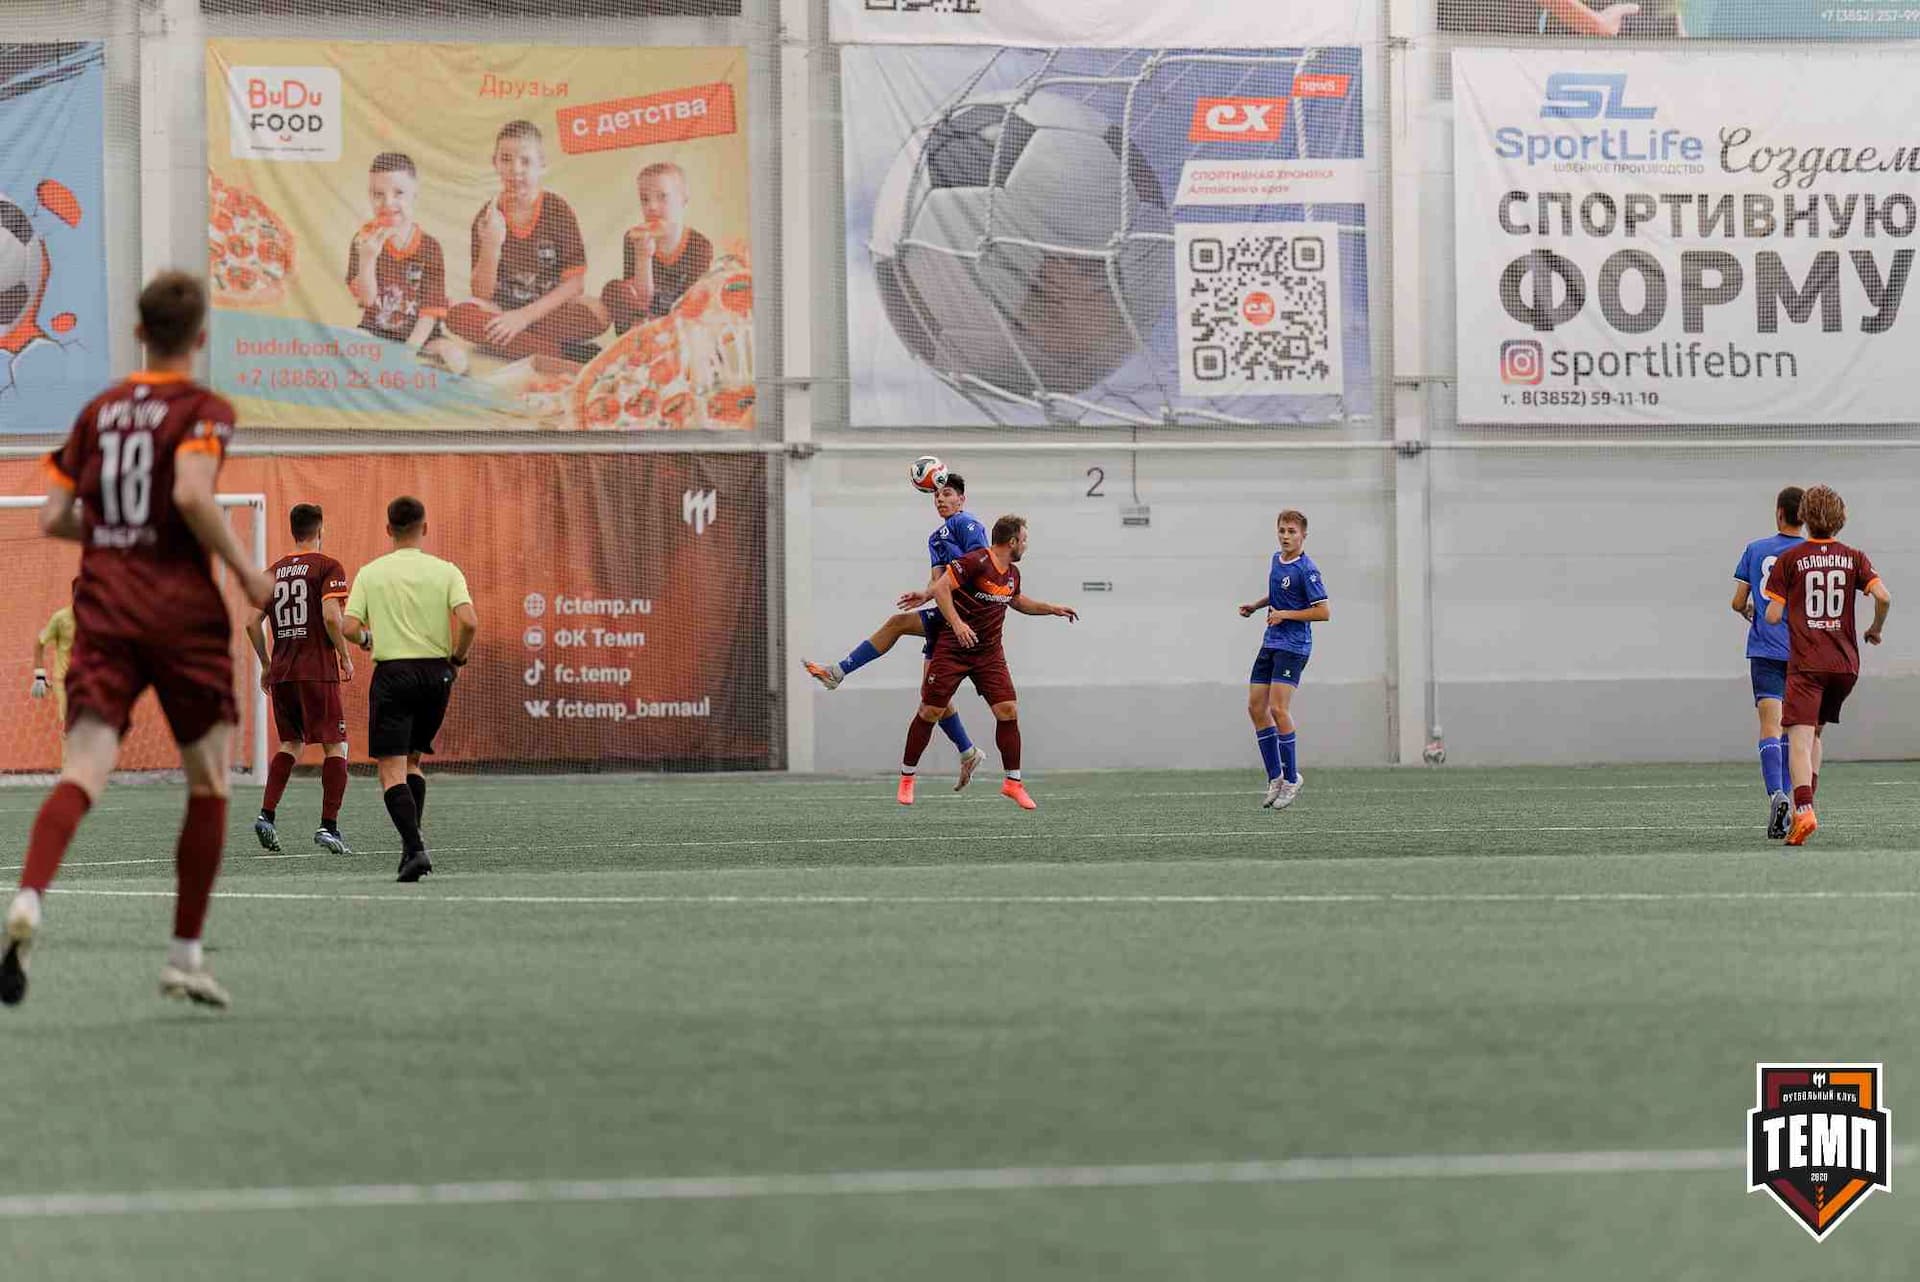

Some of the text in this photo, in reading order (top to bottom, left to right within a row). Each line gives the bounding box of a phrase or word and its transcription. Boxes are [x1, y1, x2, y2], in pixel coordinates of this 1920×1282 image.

[248, 79, 322, 109] BuDu
[480, 74, 569, 98] Друзья
[1300, 80, 1337, 92] news
[1540, 73, 1658, 120] SL
[250, 113, 323, 133] FOOD
[596, 98, 708, 137] детства
[1495, 127, 1704, 166] SportLife
[1718, 126, 1920, 190] Создаем
[1499, 191, 1917, 239] СПОРТИВНУЮ
[1499, 248, 1916, 335] ФОРМУ
[235, 337, 383, 362] budufood.org
[1550, 342, 1798, 385] sportlifebrn
[236, 369, 262, 386] +7
[270, 368, 338, 391] (3852)
[1522, 391, 1586, 406] 8(3852)
[1591, 391, 1659, 406] 59-11-10
[98, 431, 154, 527] 18
[1086, 466, 1105, 497] 2
[274, 578, 308, 628] 23
[554, 594, 652, 618] fctemp.ru
[1805, 570, 1847, 618] 66
[554, 628, 646, 648] ФК Темп
[554, 664, 632, 686] fc.temp
[557, 695, 711, 722] fctemp_barnaul
